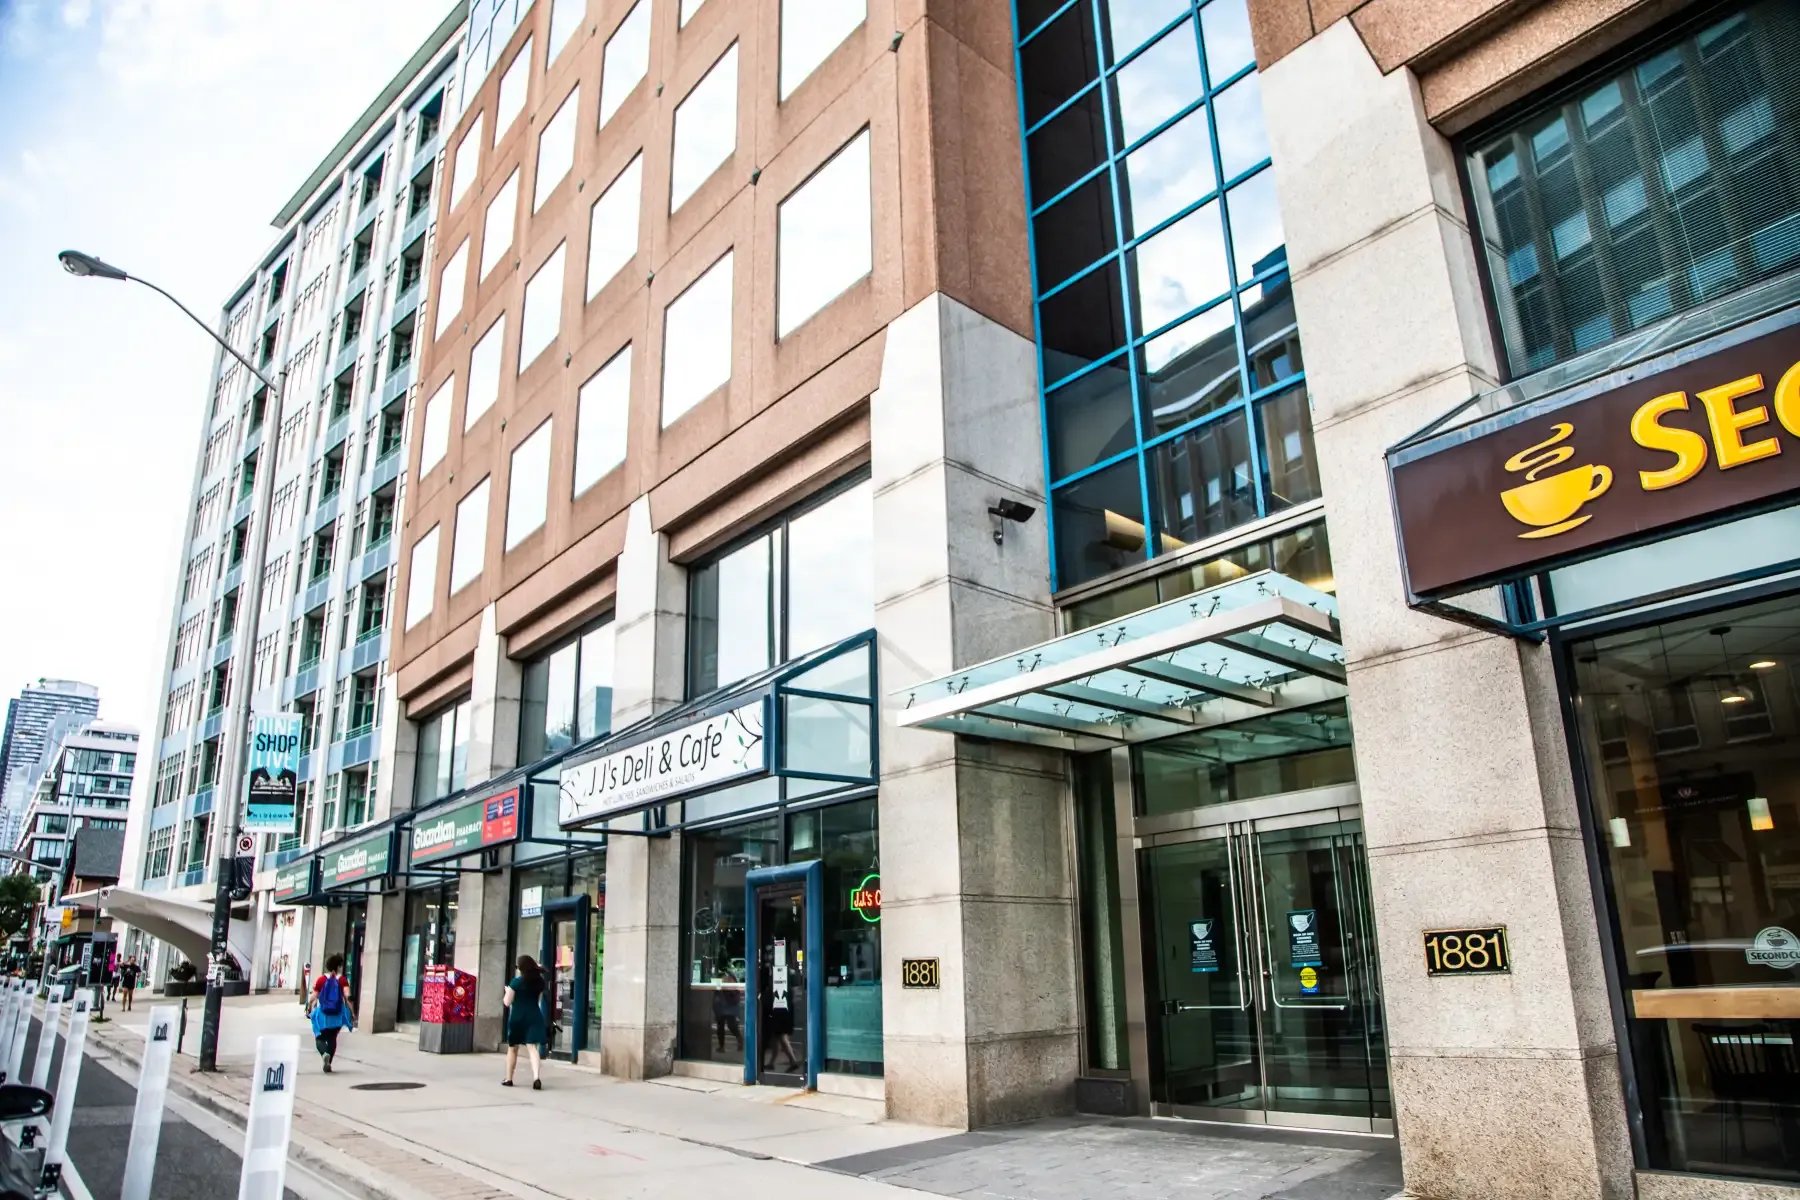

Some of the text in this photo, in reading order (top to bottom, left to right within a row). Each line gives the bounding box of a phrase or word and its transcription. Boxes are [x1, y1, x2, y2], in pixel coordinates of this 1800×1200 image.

[256, 717, 298, 735] DINE
[256, 733, 298, 754] SHOP
[256, 751, 292, 770] LIVE
[622, 745, 654, 787] Deli
[659, 740, 672, 775] &
[413, 820, 455, 850] Guardian
[1427, 933, 1502, 969] 1881
[1750, 951, 1788, 960] SECOND
[904, 961, 936, 985] 1881
